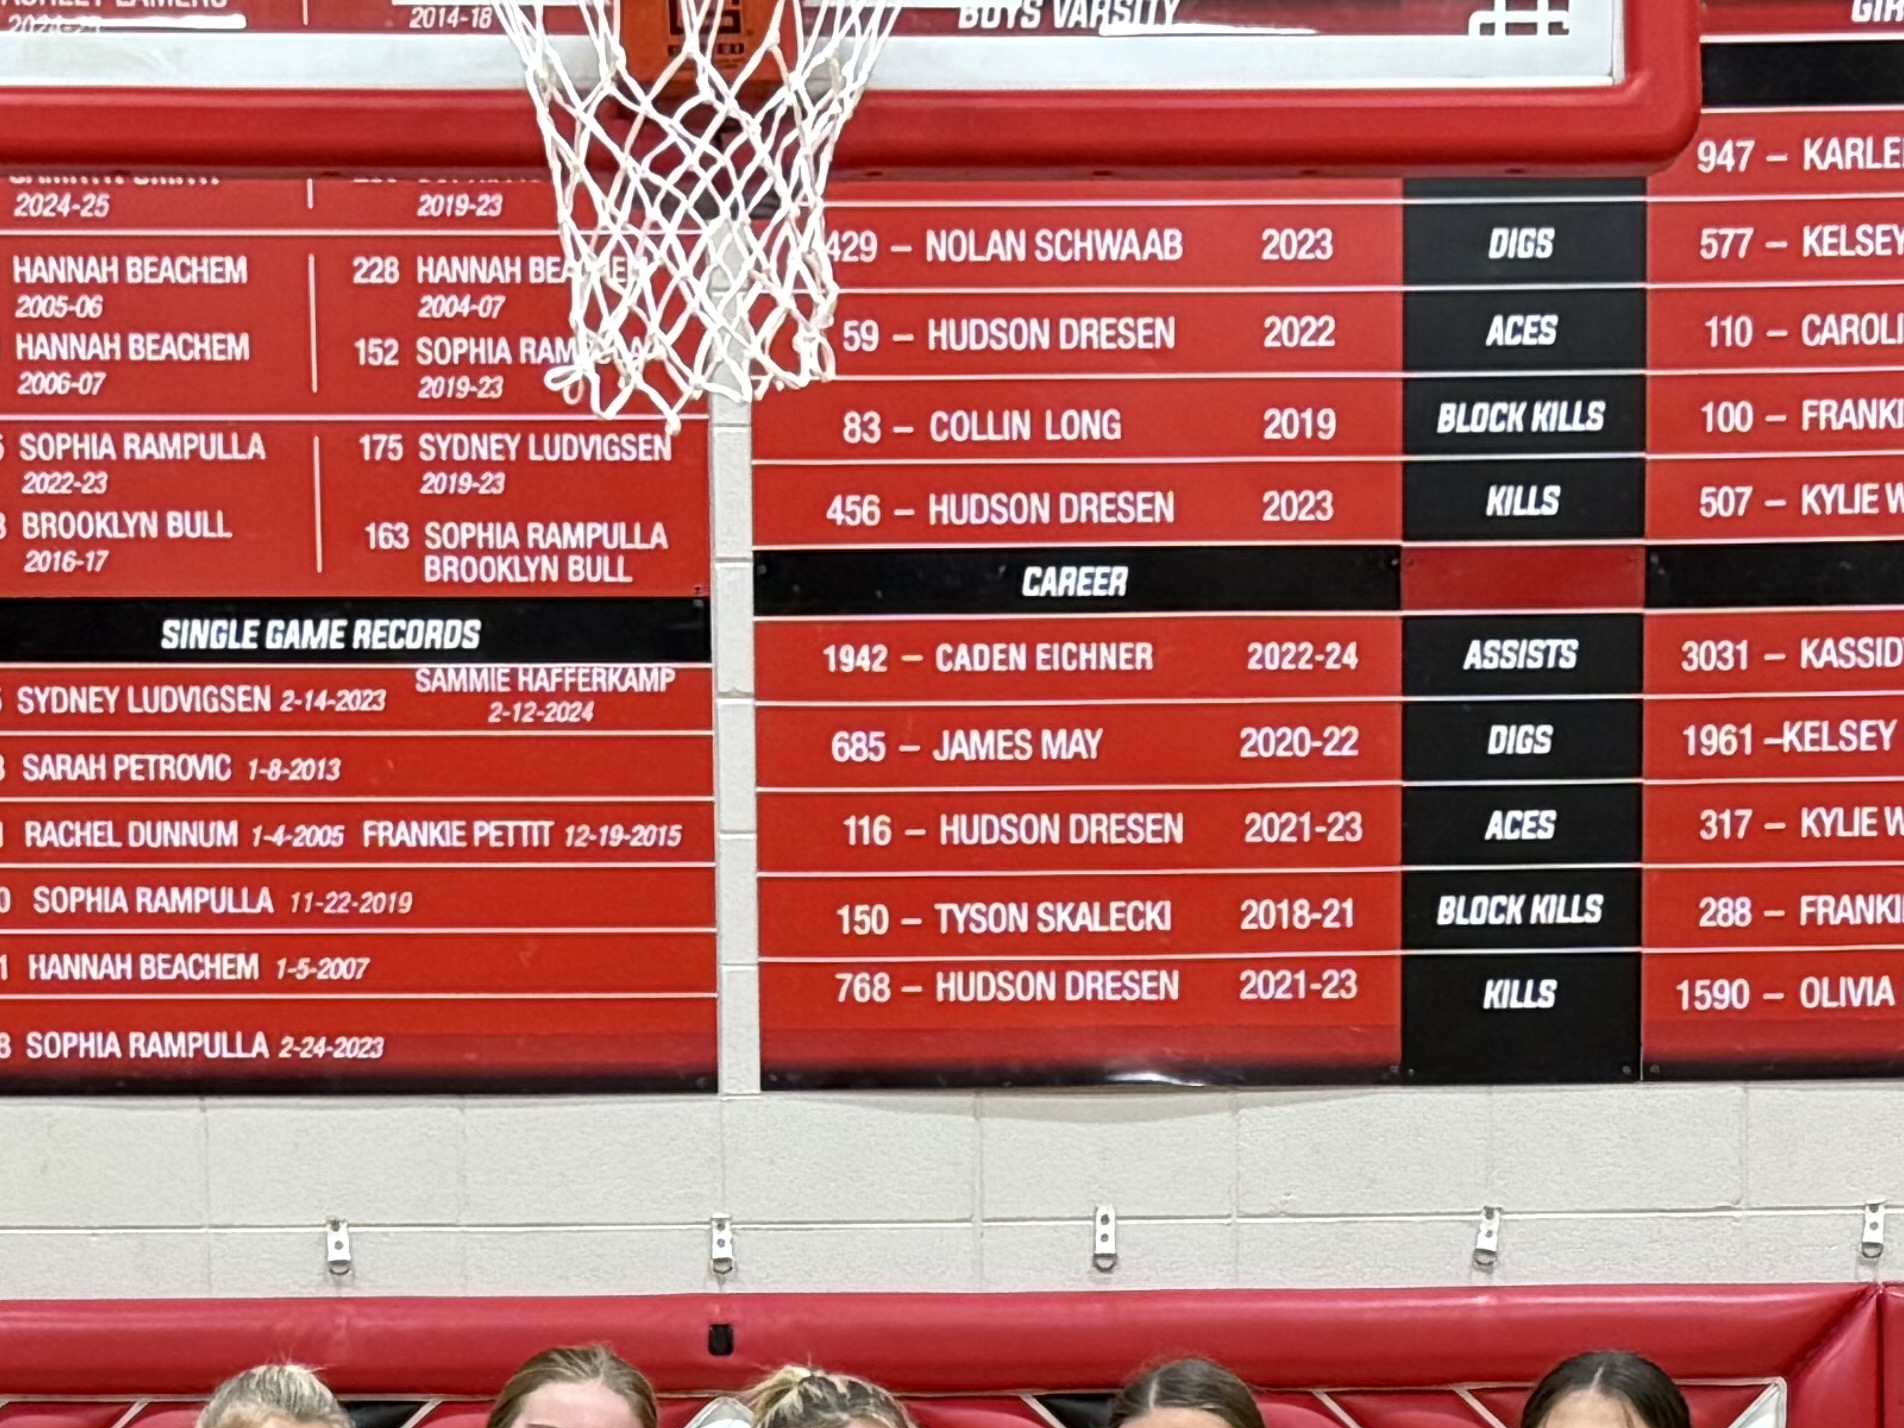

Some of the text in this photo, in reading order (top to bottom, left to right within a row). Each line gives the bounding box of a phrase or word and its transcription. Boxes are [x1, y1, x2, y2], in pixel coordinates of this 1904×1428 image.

[1698, 140, 1754, 172] 947
[1489, 228, 1555, 258] DIGS
[1486, 315, 1558, 345] ACES
[844, 408, 1336, 443] 83 COLLIN LONG 2019
[1437, 401, 1605, 433] BLOCK KILLS
[1487, 485, 1560, 516] KILLS
[23, 512, 157, 539] BROOKLYN
[167, 511, 232, 538] BULL
[24, 550, 109, 572] 2016-17
[1022, 566, 1128, 596] CAREER
[824, 642, 1358, 672] 1942 CADEN EICHNER 2022-24
[415, 669, 675, 692] SAMMIE HAFFERKAMP
[18, 686, 119, 713] SYDNEY
[128, 685, 270, 713] LUDVIGSEN
[280, 689, 386, 711] 2-14-2023
[488, 701, 594, 722] 2-12-2024
[1677, 979, 1749, 1010] 1590
[1801, 976, 1895, 1008] OLIVIA
